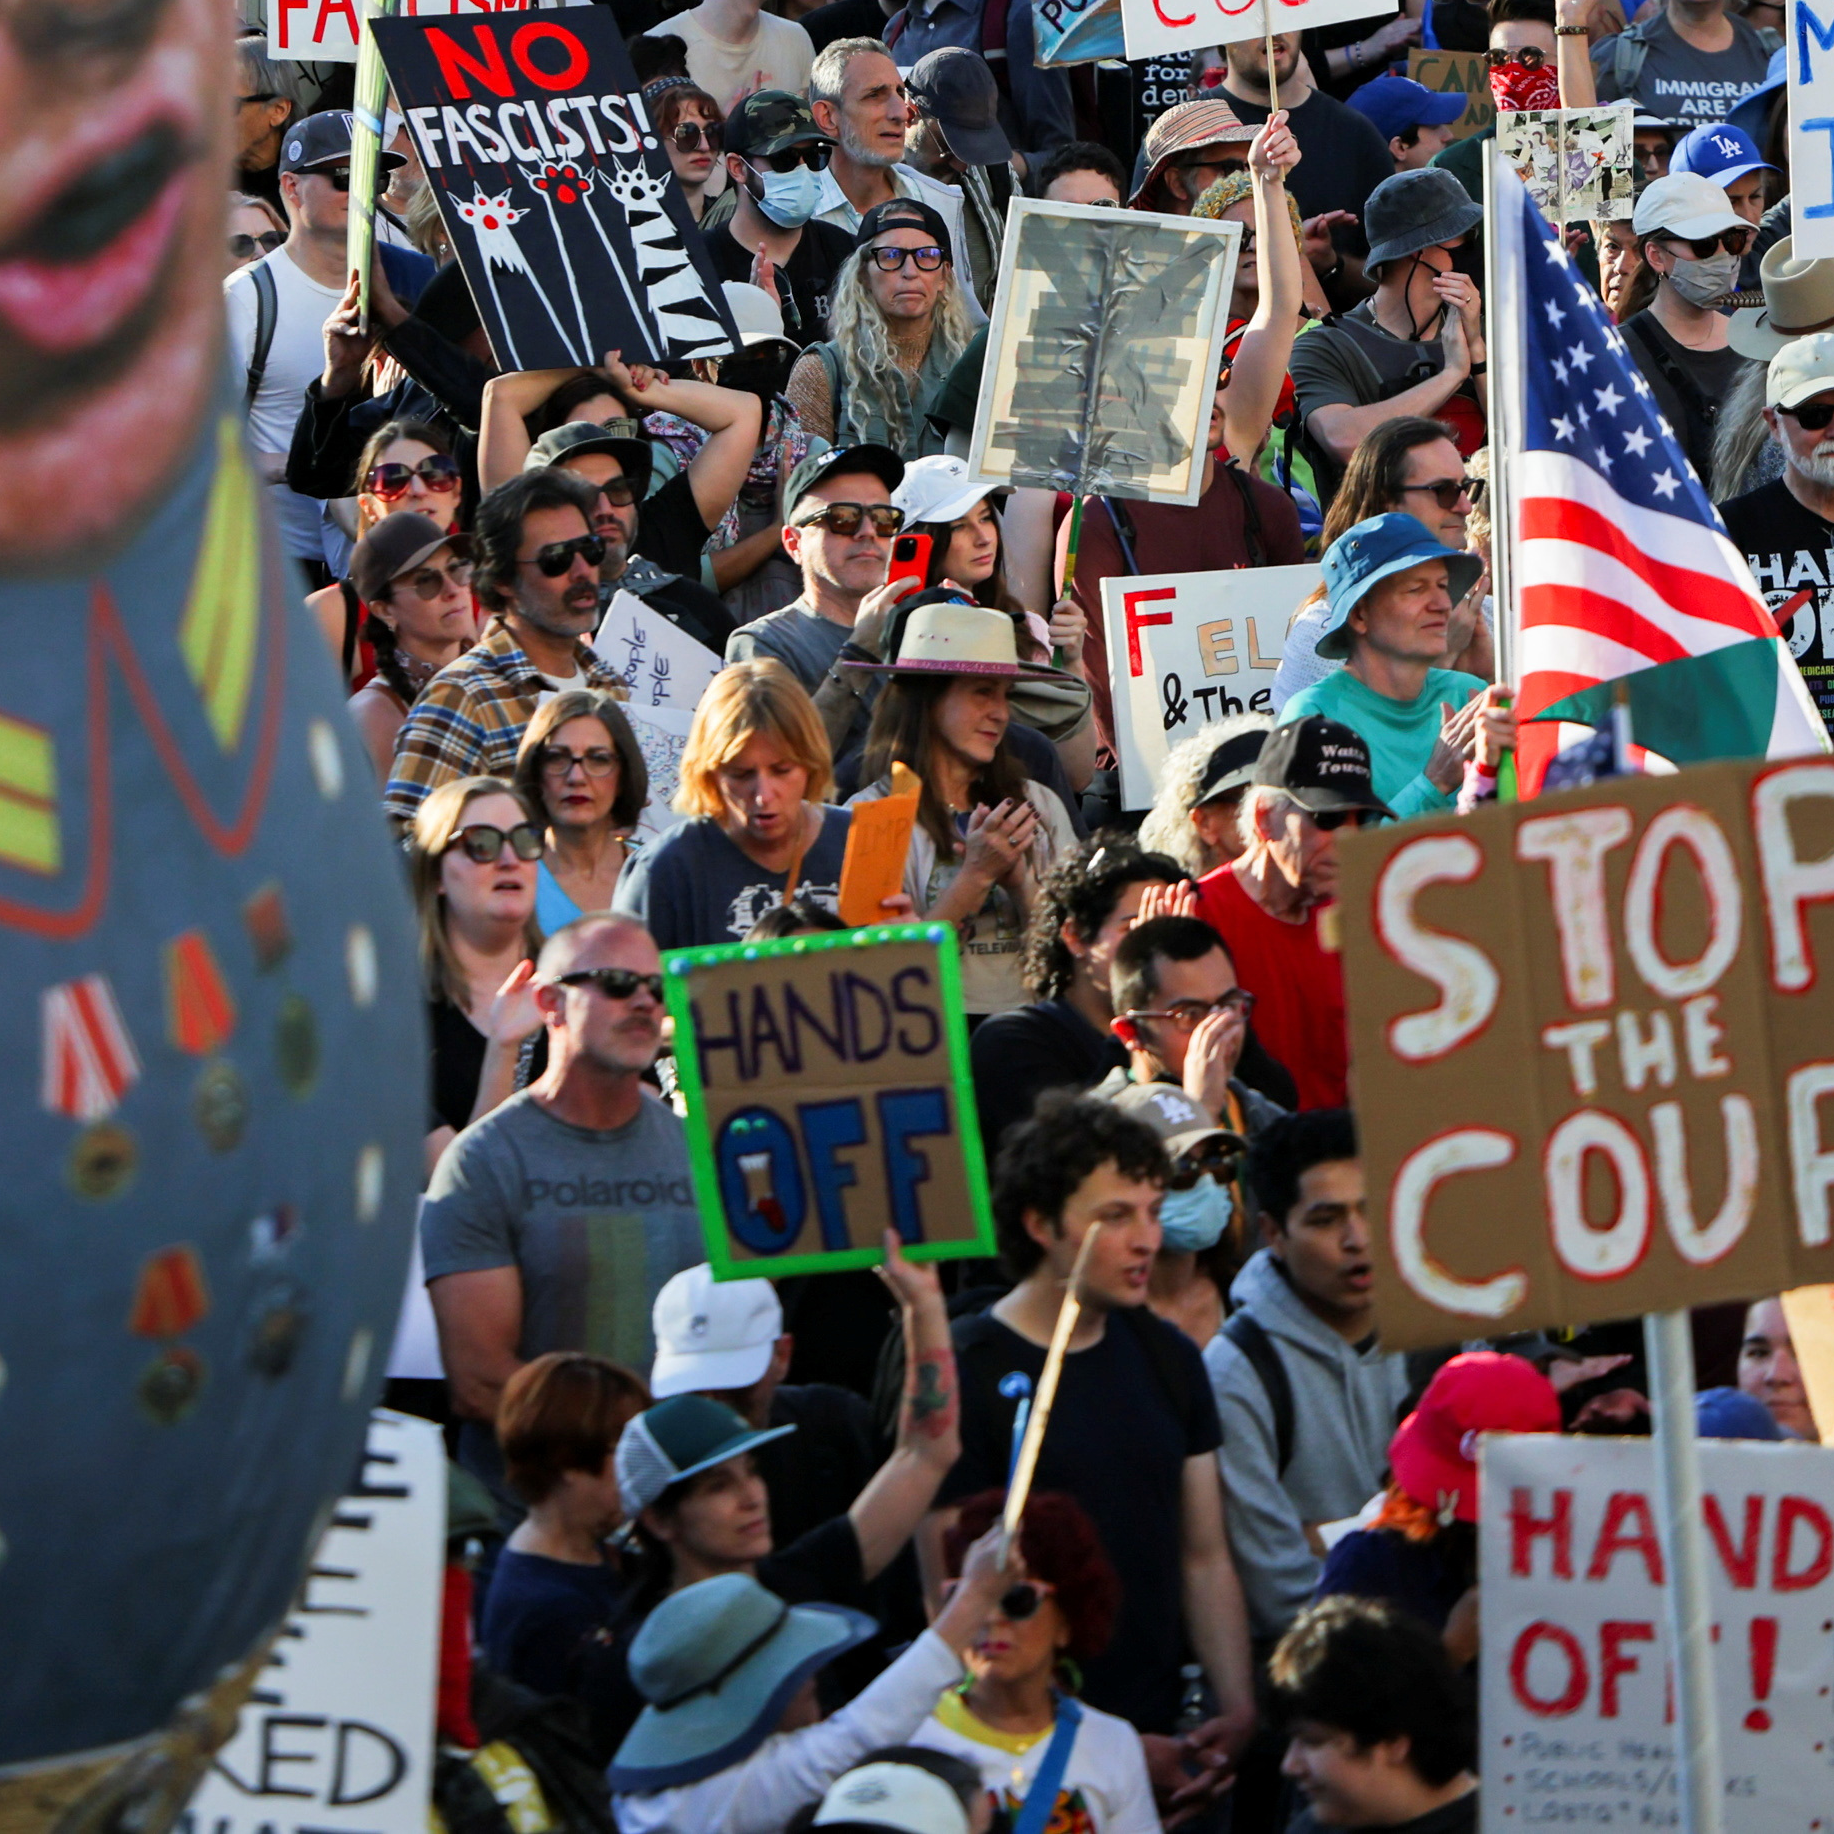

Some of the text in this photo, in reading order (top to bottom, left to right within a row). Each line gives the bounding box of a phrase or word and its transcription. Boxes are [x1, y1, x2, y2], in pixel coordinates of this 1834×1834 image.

[422, 18, 593, 102] NO
[404, 91, 661, 169] FASCISTS!
[693, 967, 941, 1088] HANDS
[1542, 994, 1733, 1094] THE
[523, 1173, 694, 1211] Polaroid
[714, 1085, 953, 1256] OFF
